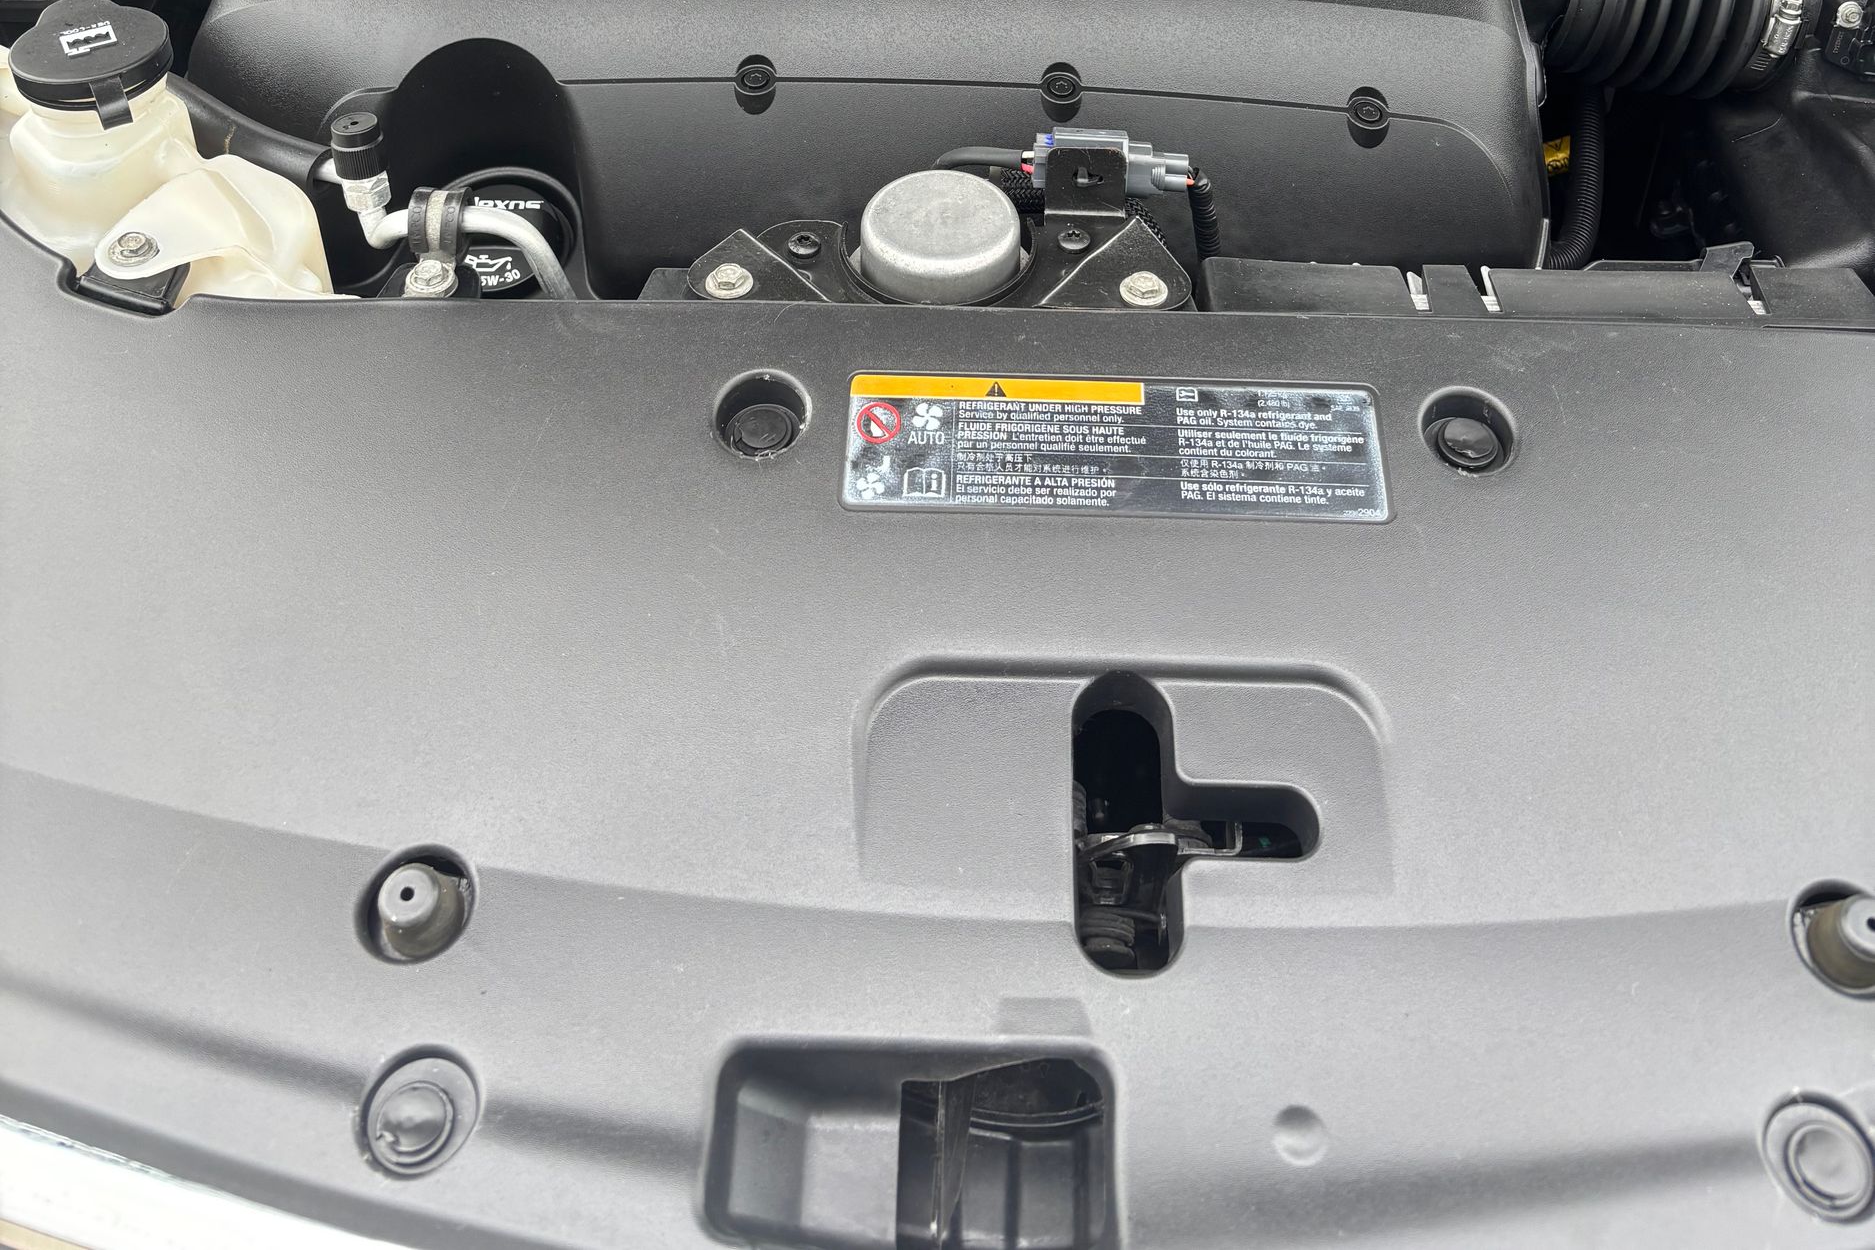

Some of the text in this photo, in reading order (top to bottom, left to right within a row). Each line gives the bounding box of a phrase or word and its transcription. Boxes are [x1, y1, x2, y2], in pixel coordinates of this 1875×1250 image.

[480, 268, 521, 286] 5W-30
[959, 402, 1142, 415] REFRIGERANT UNDER HIGH PRESSURE
[1176, 408, 1332, 422] Use only R-134a refrigerant and
[958, 410, 1124, 424] Service by qualified personnel only.
[1176, 417, 1197, 426] PAG
[1200, 418, 1214, 426] oil.
[1217, 418, 1252, 428] System
[1298, 420, 1318, 430] dye.
[958, 422, 992, 431] FLUIDE
[1062, 426, 1089, 434] SOUS
[1092, 426, 1124, 435] HAUTE
[1178, 429, 1212, 438] Utiliser
[1215, 430, 1266, 440] seulement
[1268, 432, 1277, 440] le
[1280, 432, 1308, 441] fluide
[908, 432, 945, 444] AUTO
[957, 431, 1146, 445] PRESSION L'entretien doit être effectué
[1178, 438, 1213, 447] R-134a
[1215, 440, 1224, 448] et
[1227, 439, 1240, 448] de
[1242, 440, 1272, 449] l'huile
[1274, 441, 1295, 450] PAG.
[1298, 442, 1310, 450] Le
[957, 442, 973, 450] par
[990, 442, 1038, 452] personnel
[1040, 442, 1076, 452] qualifié
[1078, 444, 1132, 453] seulement.
[1178, 447, 1277, 458] contient du colorant.
[1212, 460, 1243, 469] R-134a
[1286, 463, 1308, 472] PAG
[956, 475, 1116, 488] REFRIGERANTE A ALTA PRESIÓN
[956, 484, 1116, 498] El servicio debe ser realizado por
[1180, 480, 1365, 498] Use sólo refrigerante R-134a y aceite
[955, 494, 1110, 507] personal capacitado solamente.
[1181, 490, 1329, 504] PAG. El sistema contiene tinte.
